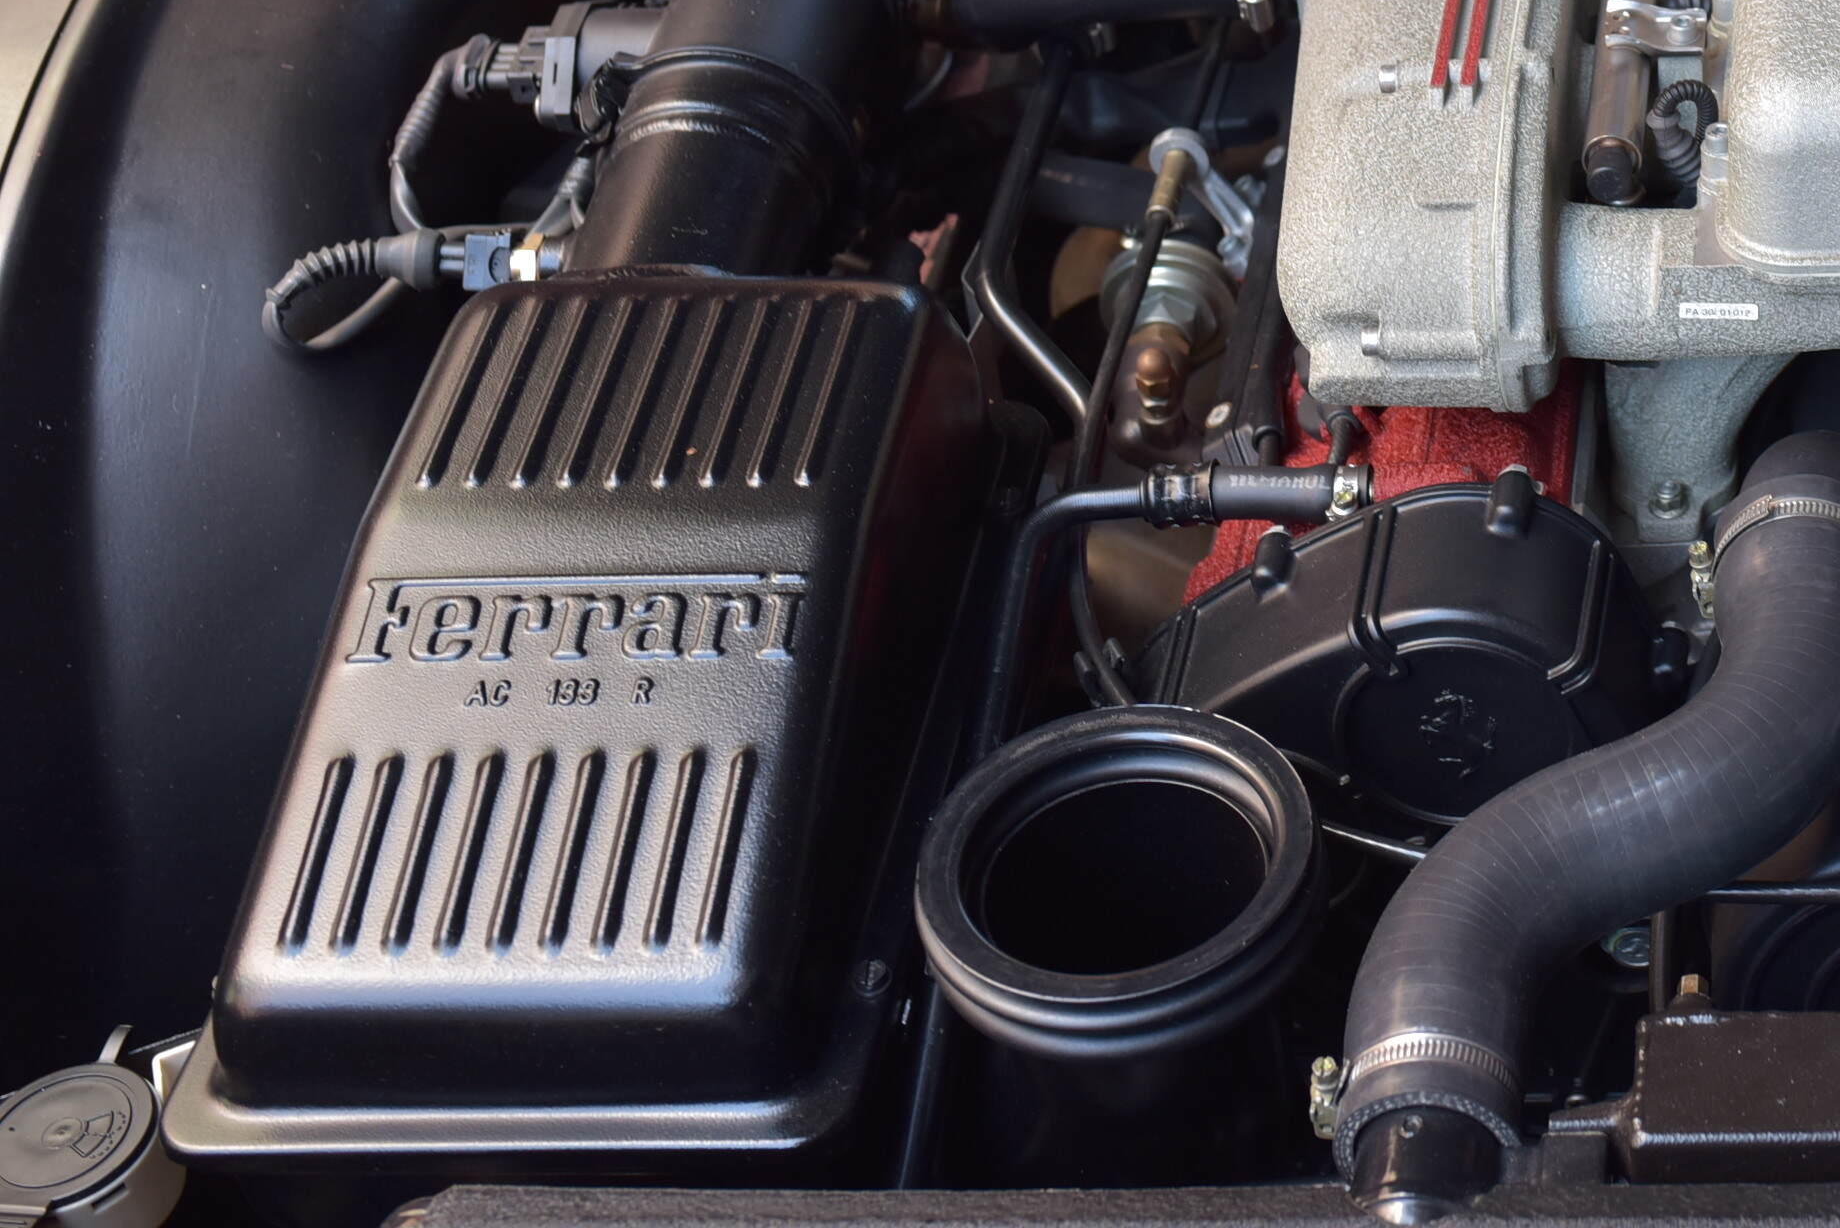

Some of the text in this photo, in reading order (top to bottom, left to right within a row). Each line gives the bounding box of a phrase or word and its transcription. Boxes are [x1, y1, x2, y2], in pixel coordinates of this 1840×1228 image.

[345, 572, 806, 664] Ferrari
[464, 676, 655, 707] AC 133 R
